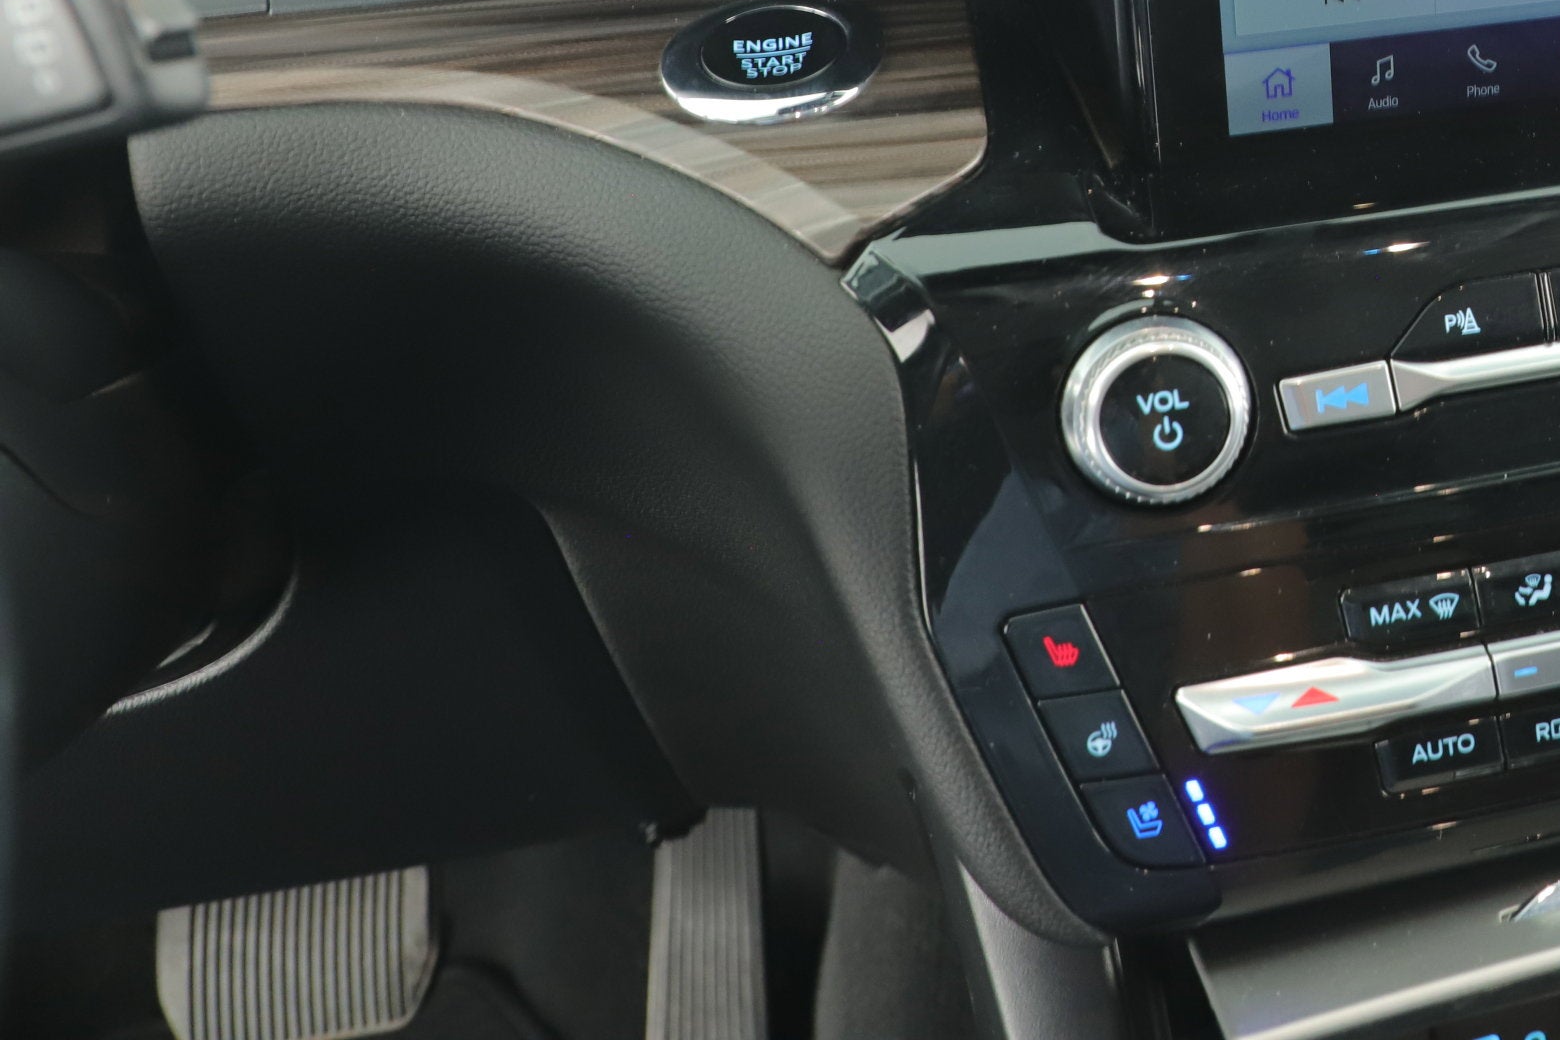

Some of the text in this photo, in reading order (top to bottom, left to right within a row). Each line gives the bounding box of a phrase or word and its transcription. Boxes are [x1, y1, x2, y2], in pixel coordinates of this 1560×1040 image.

[733, 32, 813, 54] ENGINE
[741, 52, 807, 70] START
[746, 63, 802, 79] STOP
[1466, 83, 1500, 98] Phone
[1368, 96, 1399, 110] Audio
[1261, 109, 1300, 123] Home
[1136, 388, 1190, 415] VOL
[1370, 599, 1422, 627] MAX
[1412, 733, 1476, 764] AUTO
